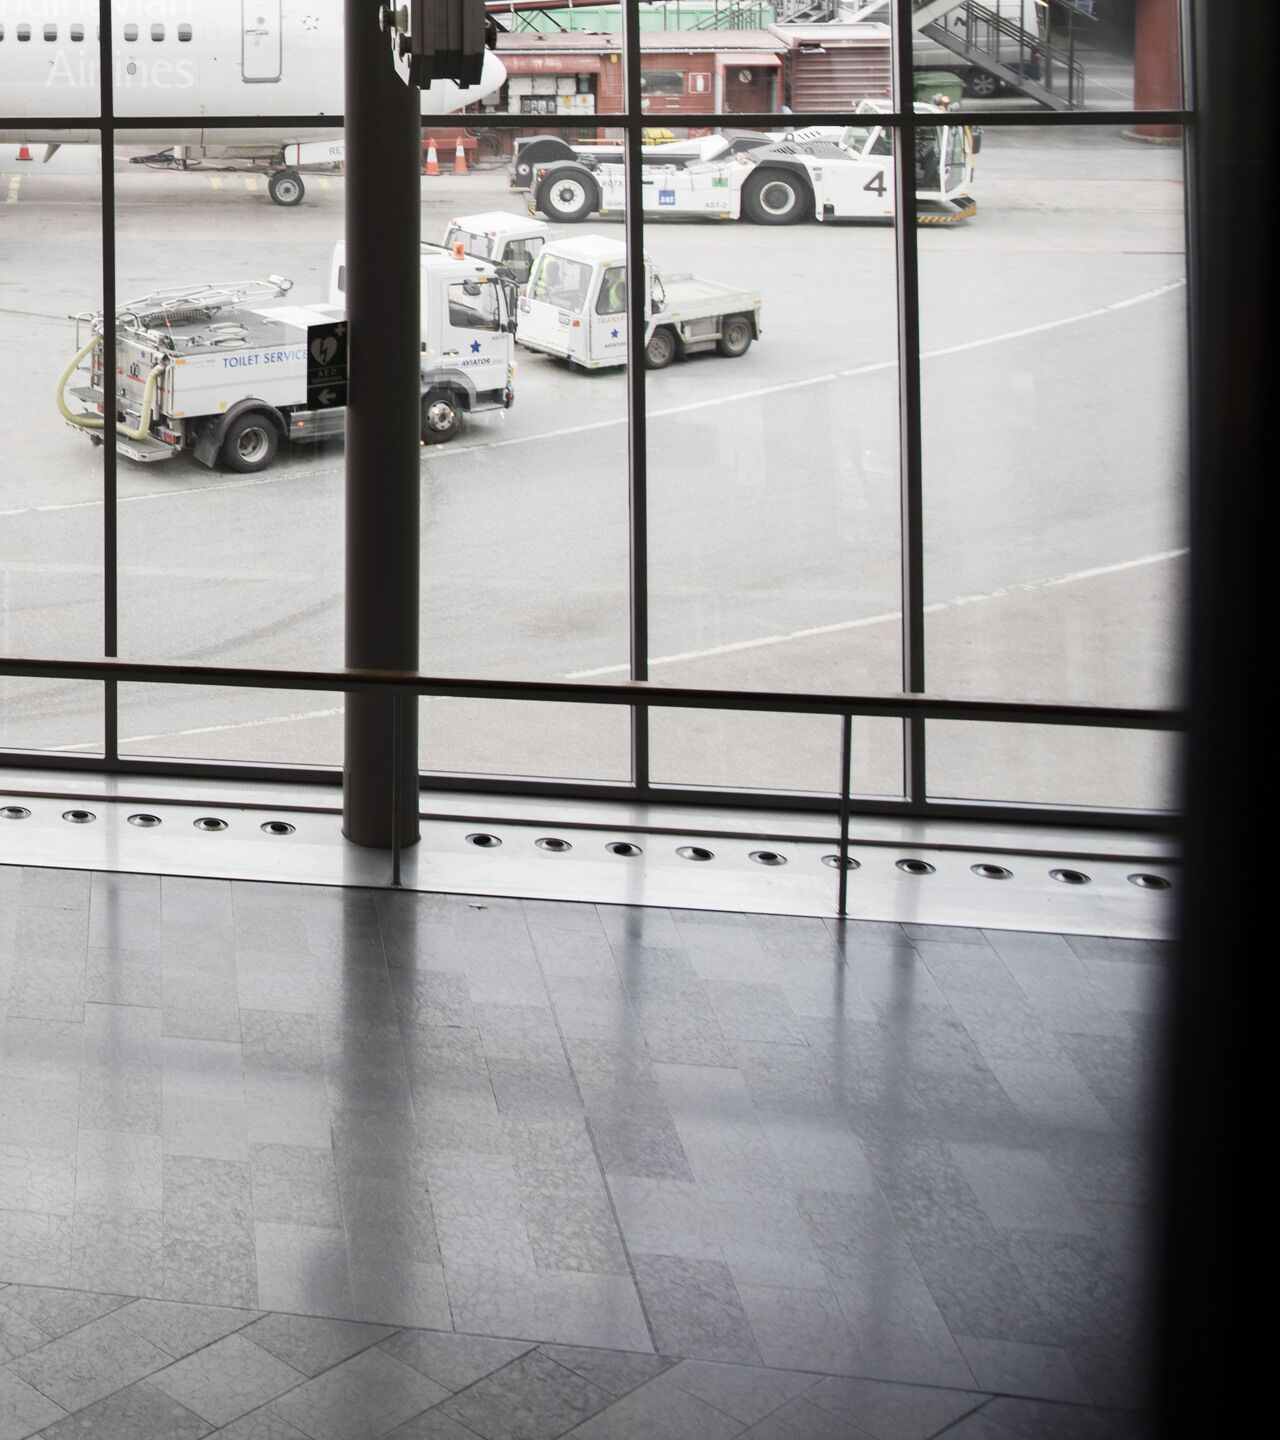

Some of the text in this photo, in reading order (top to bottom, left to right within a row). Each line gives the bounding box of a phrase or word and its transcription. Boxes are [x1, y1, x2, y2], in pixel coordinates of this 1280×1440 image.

[863, 170, 887, 198] 4
[223, 353, 260, 368] TOILET
[461, 357, 491, 366] AVIATOR
